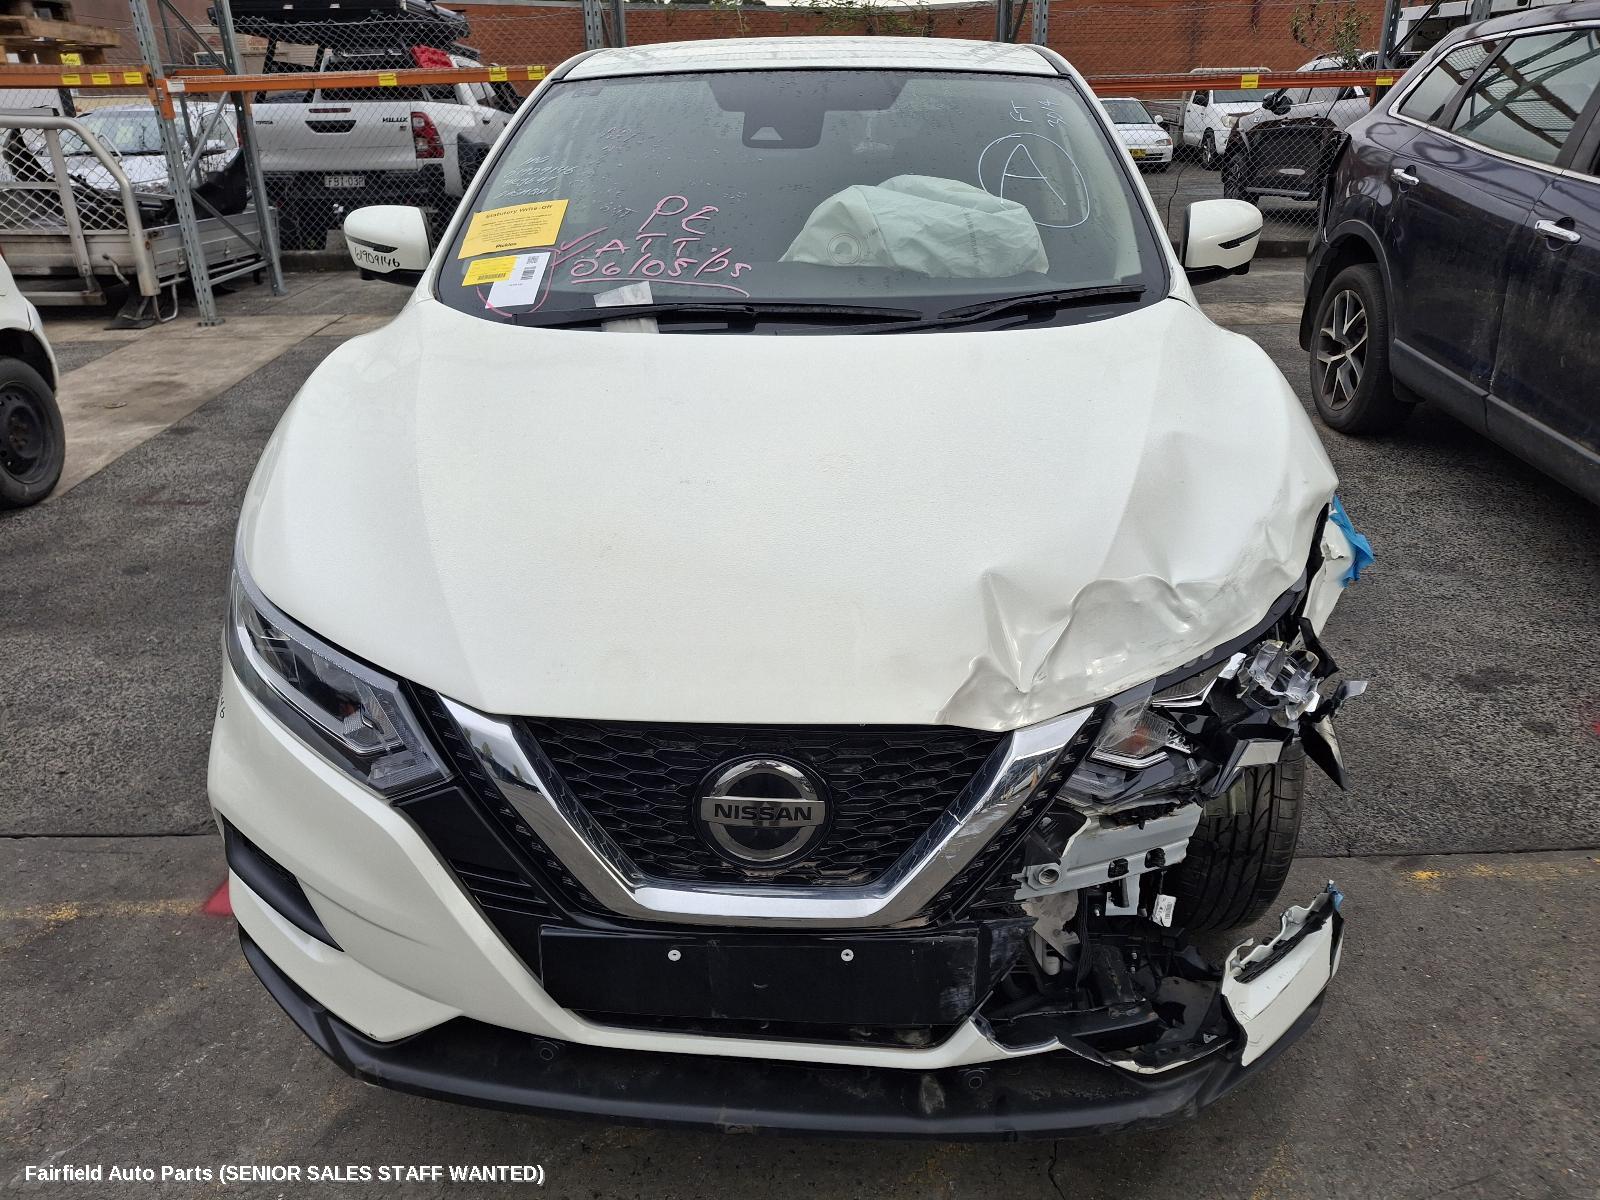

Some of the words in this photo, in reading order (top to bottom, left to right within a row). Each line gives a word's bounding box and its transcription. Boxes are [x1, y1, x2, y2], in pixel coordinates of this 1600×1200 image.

[1000, 143, 1067, 205] A
[354, 247, 400, 268] 61909146
[714, 803, 812, 821] NISSAN
